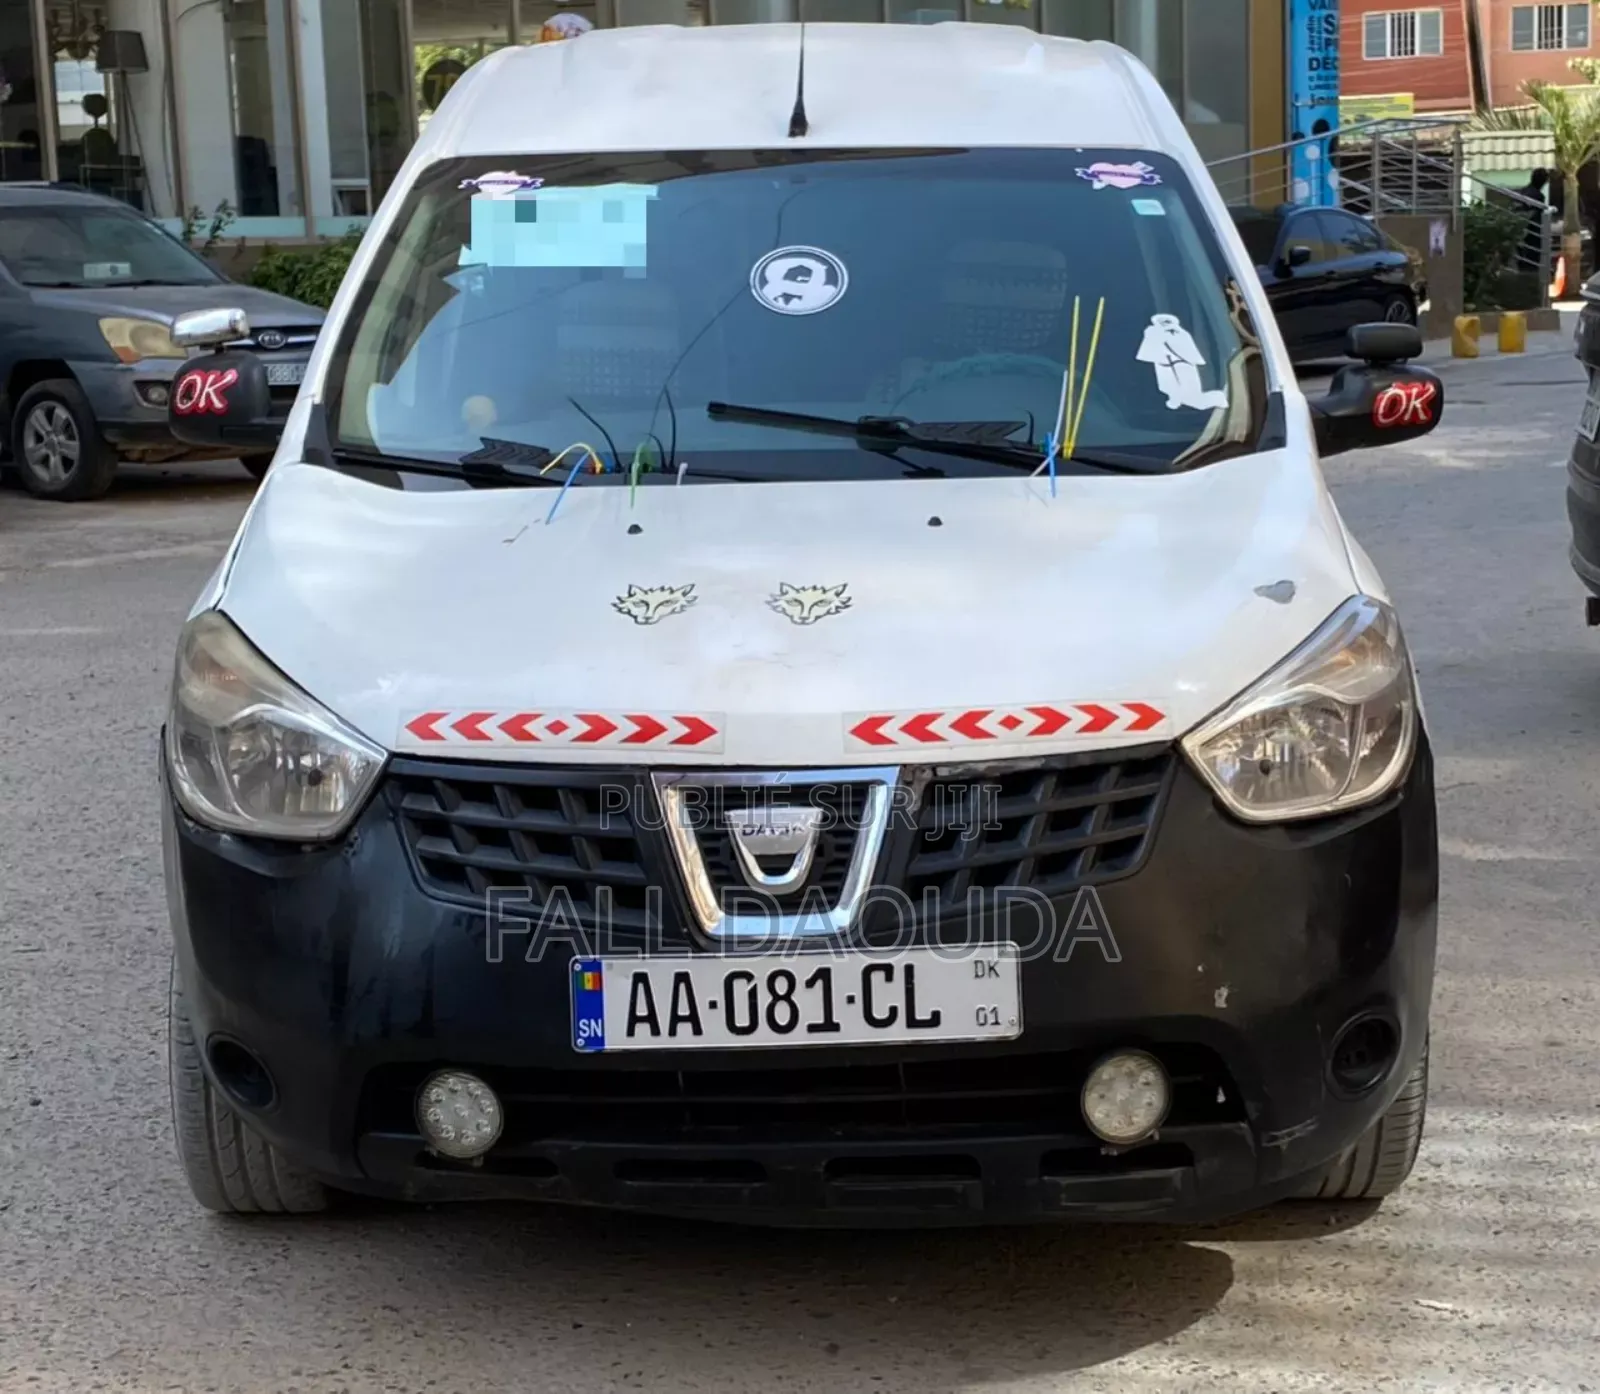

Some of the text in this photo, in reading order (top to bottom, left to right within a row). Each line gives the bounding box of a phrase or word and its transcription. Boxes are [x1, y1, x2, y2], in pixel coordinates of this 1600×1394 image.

[176, 370, 238, 412] OK
[1375, 382, 1436, 424] OK
[973, 959, 1001, 979] DK
[579, 1018, 602, 1038] SN
